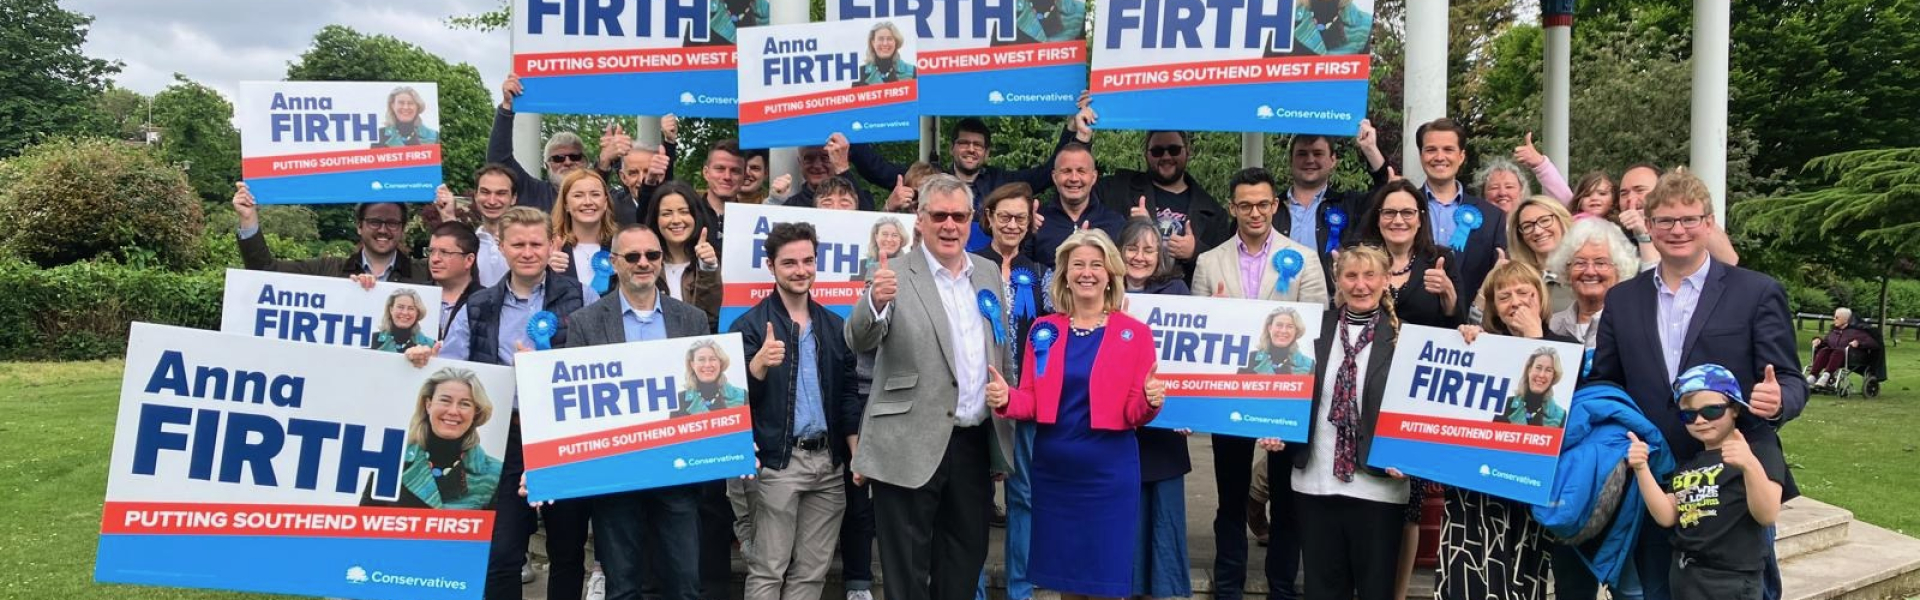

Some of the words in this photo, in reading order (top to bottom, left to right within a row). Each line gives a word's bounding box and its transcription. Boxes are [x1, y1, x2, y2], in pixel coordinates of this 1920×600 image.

[1106, 0, 1294, 50] FIRTH
[763, 37, 817, 55] Anna
[527, 57, 594, 72] PUTTING
[597, 53, 683, 69] SOUTHEND
[686, 52, 728, 66] WEST
[763, 53, 859, 86] FIRTH
[918, 54, 990, 70] OUTHEND
[994, 50, 1034, 66] WEST
[1037, 47, 1078, 61] FIRST
[1103, 68, 1169, 88] PUTTING
[1172, 65, 1262, 82] SOUTHEND
[1266, 63, 1311, 77] WEST
[1315, 61, 1361, 75] FIRST
[270, 92, 332, 110] Anna
[697, 94, 738, 104] Conserv
[764, 101, 804, 115] PUTTING
[805, 95, 855, 109] SOUTHEND
[857, 90, 882, 103] WEST
[884, 86, 910, 98] FIRST
[1006, 92, 1074, 102] Conservatives
[863, 120, 910, 130] Conservatives
[1276, 107, 1351, 121] Conservatives
[270, 113, 377, 142] FIRTH
[273, 158, 318, 171] PUTTING
[319, 155, 375, 168] SOUTHEND
[376, 152, 403, 163] WEST
[405, 150, 432, 160] FIRST
[384, 181, 433, 189] Conservatives
[752, 239, 859, 274] FTH
[257, 284, 325, 309] Anna
[811, 288, 853, 298] UTHEND
[254, 308, 372, 347] FIRTH
[1147, 307, 1207, 329] Anna
[1418, 340, 1475, 368] Anna
[144, 350, 305, 408] Anna
[551, 360, 623, 384] Anna
[1181, 380, 1240, 391] SOUTHEND
[1241, 380, 1271, 391] WEST
[1272, 381, 1304, 392] FIRST
[1408, 365, 1511, 413] FIRTH
[552, 376, 678, 422] FIRTH
[1243, 414, 1298, 426] Conservatives
[558, 438, 611, 457] PUTTING
[611, 426, 676, 448] SOUTHEND
[677, 419, 709, 435] WEST
[711, 414, 741, 429] FIRST
[1400, 421, 1441, 435] PUTTING
[1440, 425, 1493, 441] SOUTHEND
[1494, 430, 1522, 444] WEST
[1522, 434, 1553, 447] FIRST
[131, 403, 405, 498] FIRTH
[688, 453, 745, 467] Conservatives
[1491, 468, 1542, 488] Conservatives
[124, 510, 228, 528] PUTTING
[232, 511, 357, 530] SOUTHEND
[360, 514, 421, 532] WEST
[425, 517, 483, 534] FIRST
[371, 571, 467, 590] Conservatives
